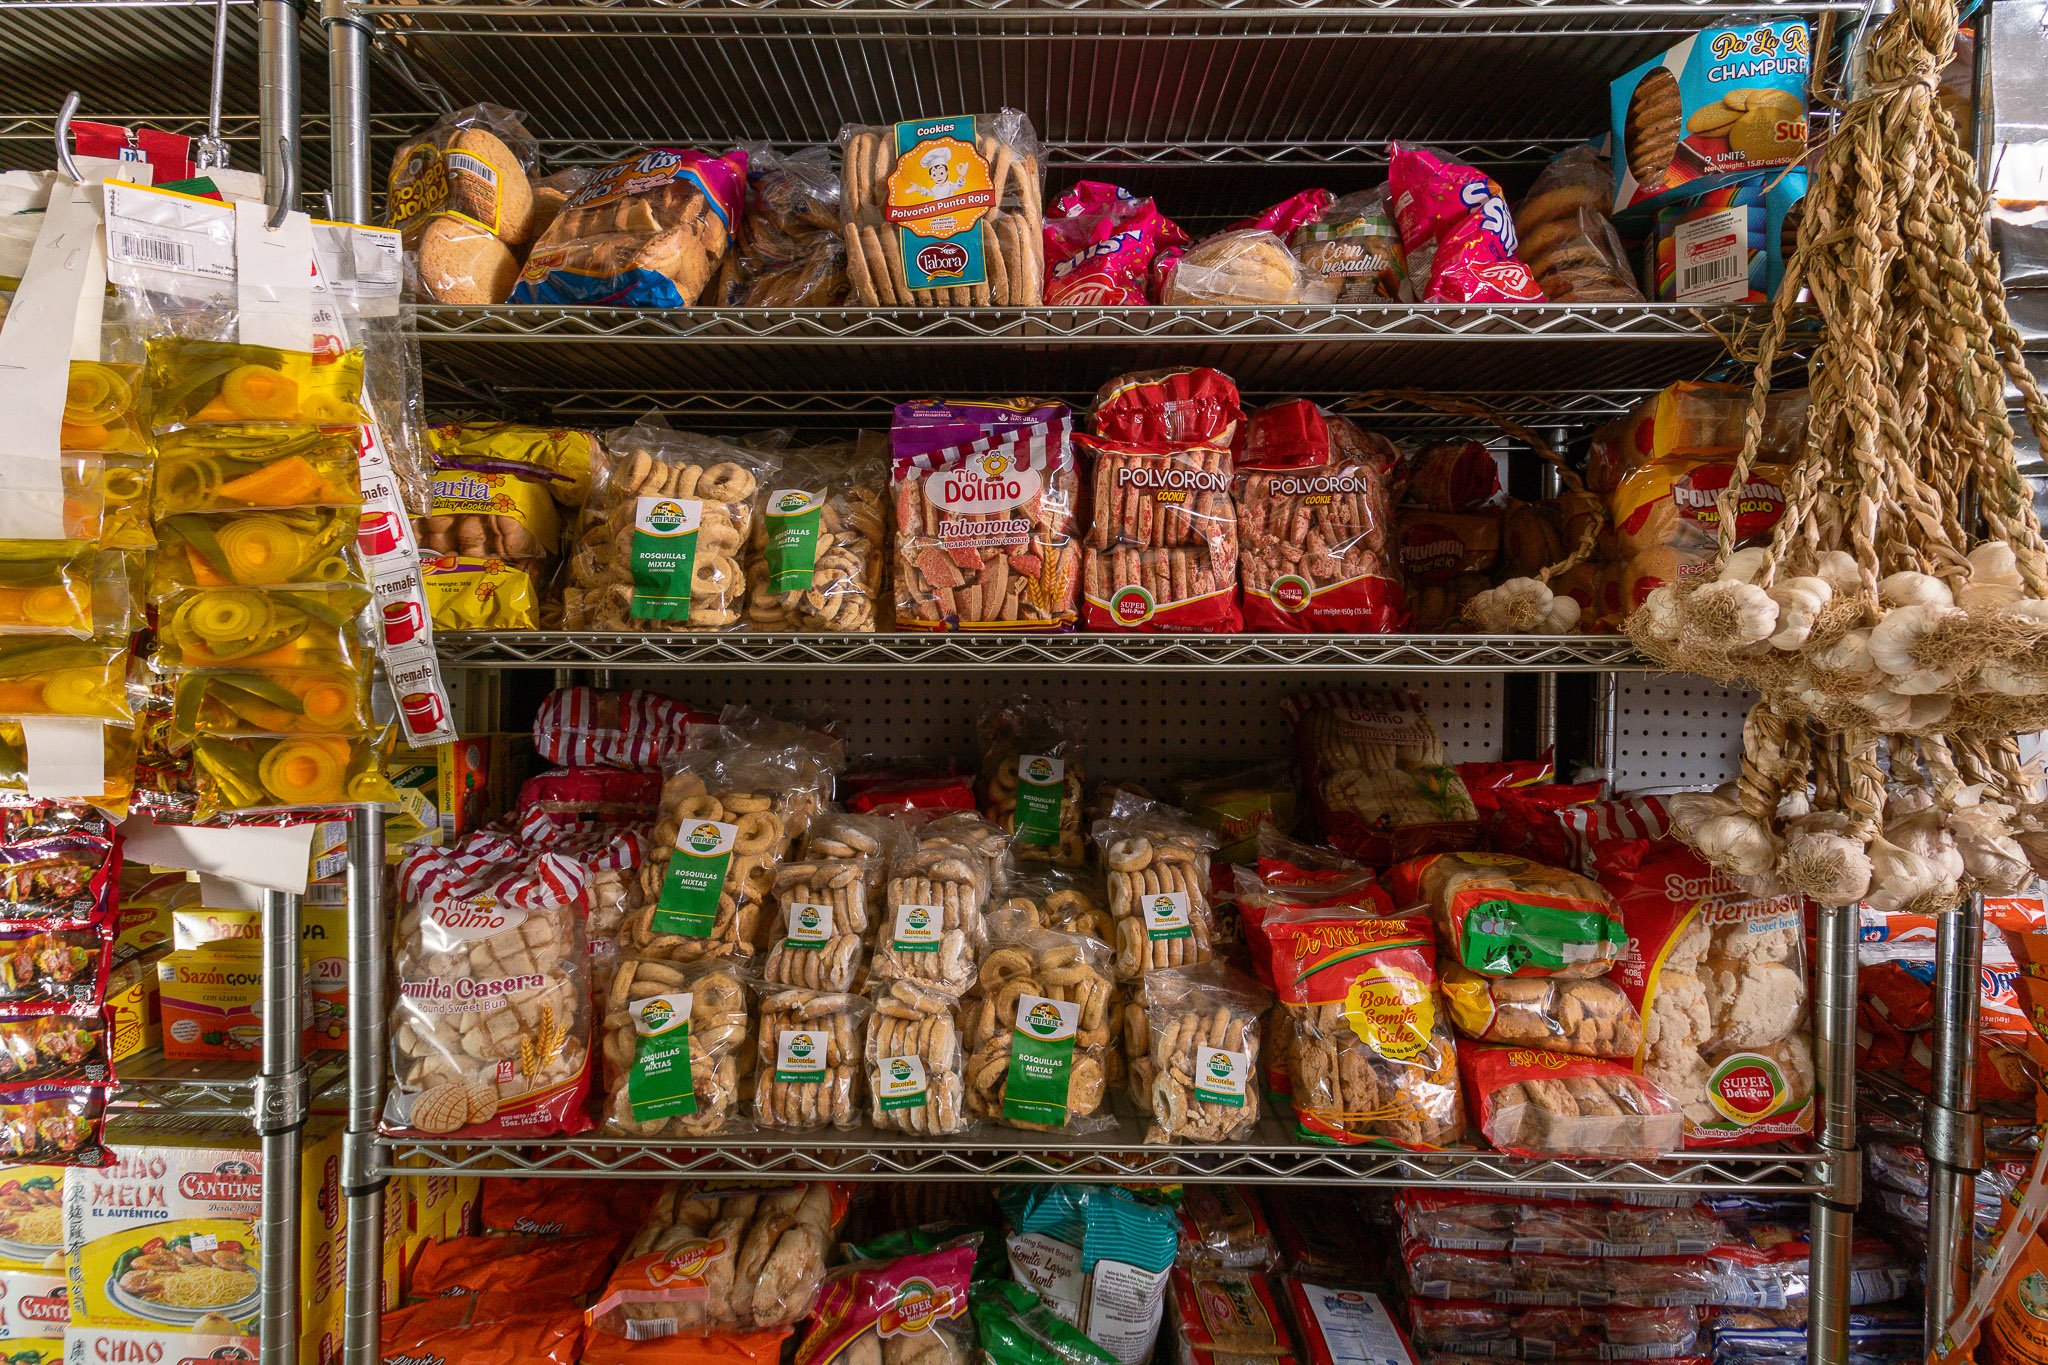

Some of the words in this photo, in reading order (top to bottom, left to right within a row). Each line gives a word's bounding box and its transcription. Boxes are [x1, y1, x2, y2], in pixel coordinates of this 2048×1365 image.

[1754, 29, 1779, 56] La
[917, 123, 955, 137] Cookies
[1717, 151, 1745, 164] UNITS
[1704, 165, 1718, 174] Net
[1719, 161, 1745, 173] Weight:
[1747, 160, 1765, 168] 15.87
[891, 204, 936, 219] Polvorón
[937, 196, 966, 211] Punto
[968, 192, 990, 206] Rojo
[1322, 241, 1363, 261] Corn
[920, 254, 962, 270] Tabora
[955, 470, 977, 483] Tío
[1119, 468, 1226, 492] POLVORON
[945, 479, 1021, 503] Dolmo
[1270, 477, 1367, 495] POLVORON
[1157, 491, 1187, 503] COOKIE
[1305, 494, 1332, 505] COOKIE
[1675, 483, 1784, 508] POLVRON
[434, 499, 457, 511] Daisy
[461, 500, 492, 512] Cookie
[1740, 501, 1773, 514] ROJO
[940, 520, 1029, 537] Polvorones
[375, 576, 417, 595] cremafe
[1120, 602, 1146, 610] SUPER
[395, 665, 432, 684] cremafe
[675, 870, 717, 880] ROSQUILLAS
[681, 879, 707, 887] MIXTAS
[1665, 874, 1740, 901] Semi
[1700, 895, 1799, 926] Hermosa
[1748, 921, 1777, 934] Sweet
[180, 966, 226, 984] Sazón
[319, 962, 342, 978] 20
[1624, 969, 1642, 978] 408g
[399, 976, 451, 1000] emita
[456, 973, 544, 998] Casera
[447, 1001, 481, 1013] Sweet
[483, 999, 506, 1011] Bun
[1377, 1023, 1416, 1043] Cake
[499, 1061, 512, 1073] 12
[1019, 1054, 1062, 1066] ROSQUILLAS
[1026, 1065, 1053, 1074] MIXTAS
[1722, 1077, 1769, 1088] SUPER
[1694, 1127, 1728, 1137] Nuestro
[1750, 1125, 1765, 1134] por
[97, 1155, 167, 1180] HAO
[93, 1209, 104, 1217] EL
[107, 1207, 168, 1218] AUTÉNTICO
[208, 1203, 234, 1212] Desde
[1021, 1236, 1036, 1249] Long
[1036, 1242, 1055, 1255] Sweet
[1055, 1249, 1074, 1261] Bread
[670, 1247, 706, 1268] SUPER
[1043, 1257, 1072, 1278] Larga
[898, 1299, 932, 1319] SUPER
[94, 1336, 163, 1363] CHAO
